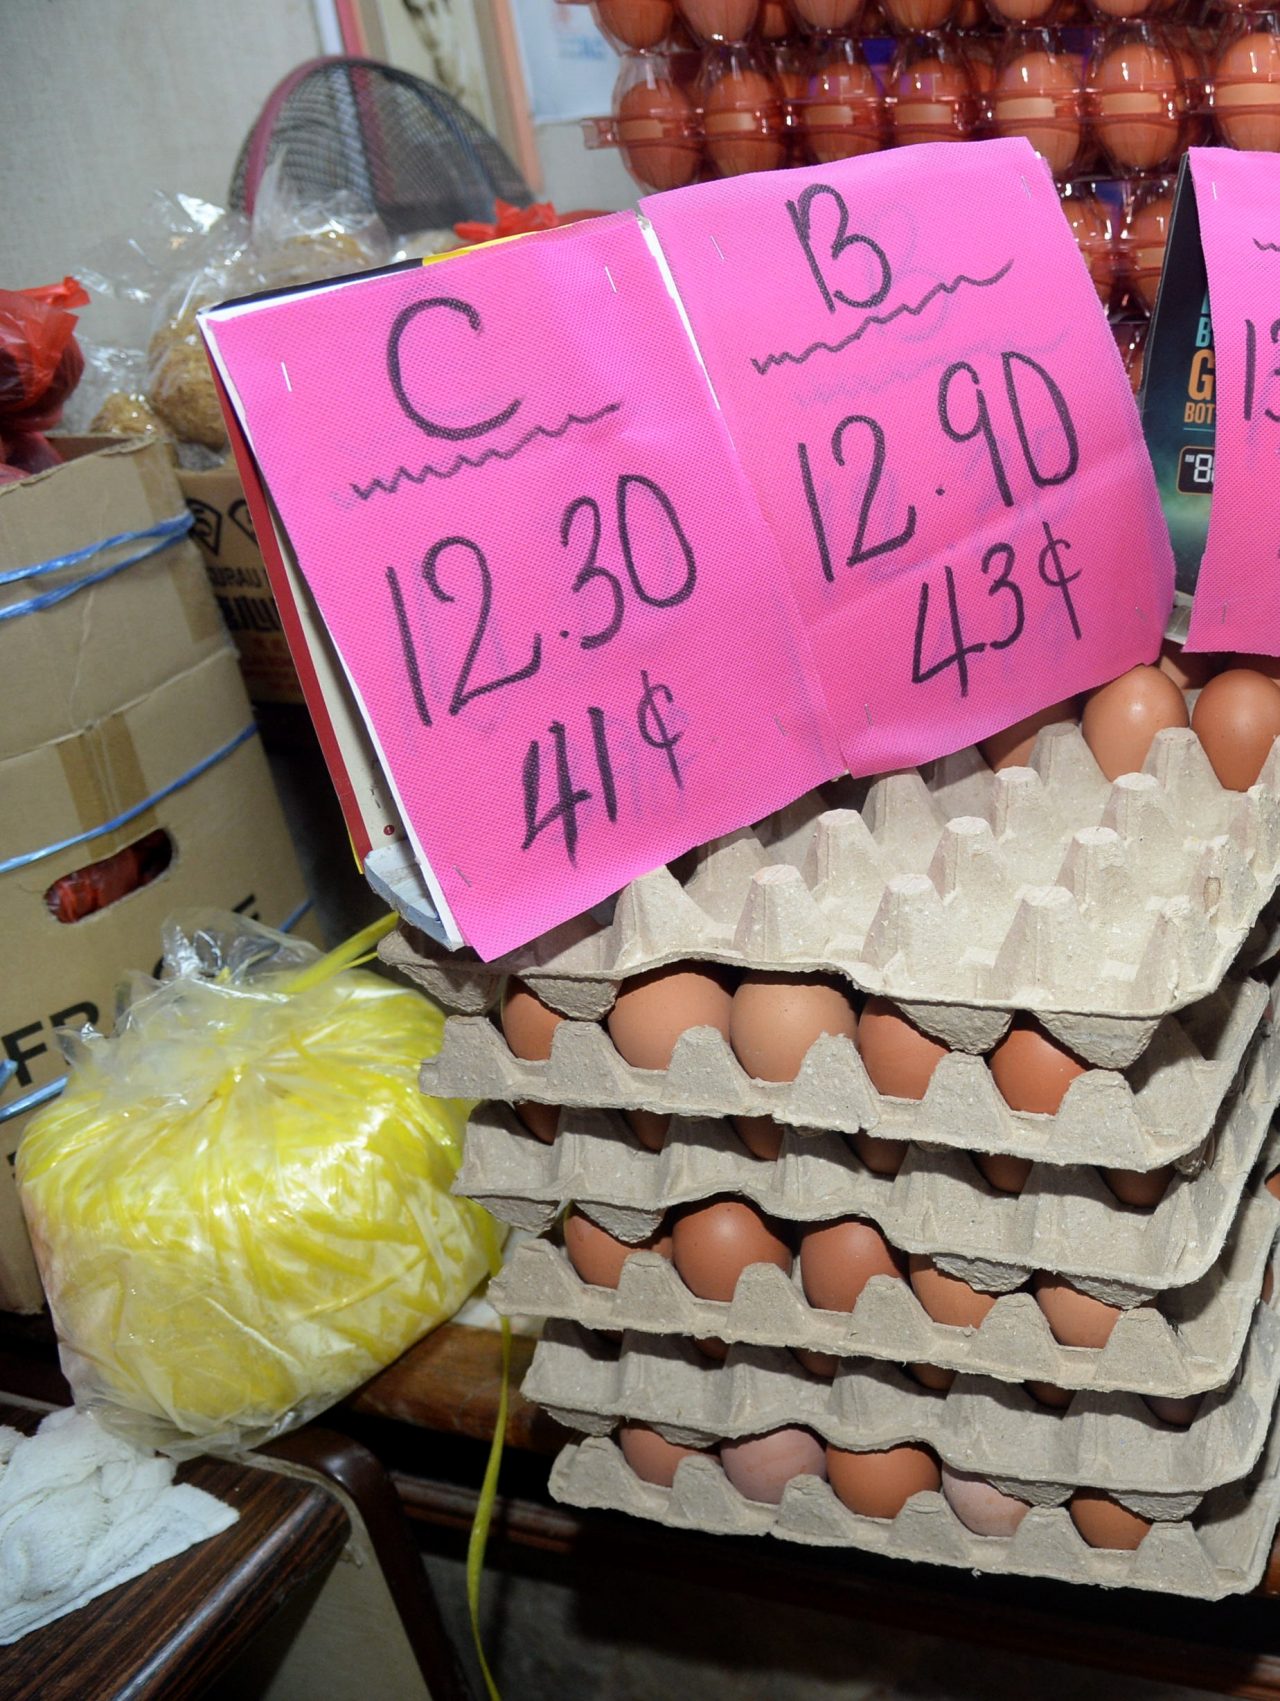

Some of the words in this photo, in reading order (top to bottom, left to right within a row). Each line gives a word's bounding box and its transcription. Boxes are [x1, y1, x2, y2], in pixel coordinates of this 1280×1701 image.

[784, 182, 893, 314] B
[386, 296, 523, 441] C
[798, 351, 1079, 583] 12.90
[386, 474, 697, 727] 12.30
